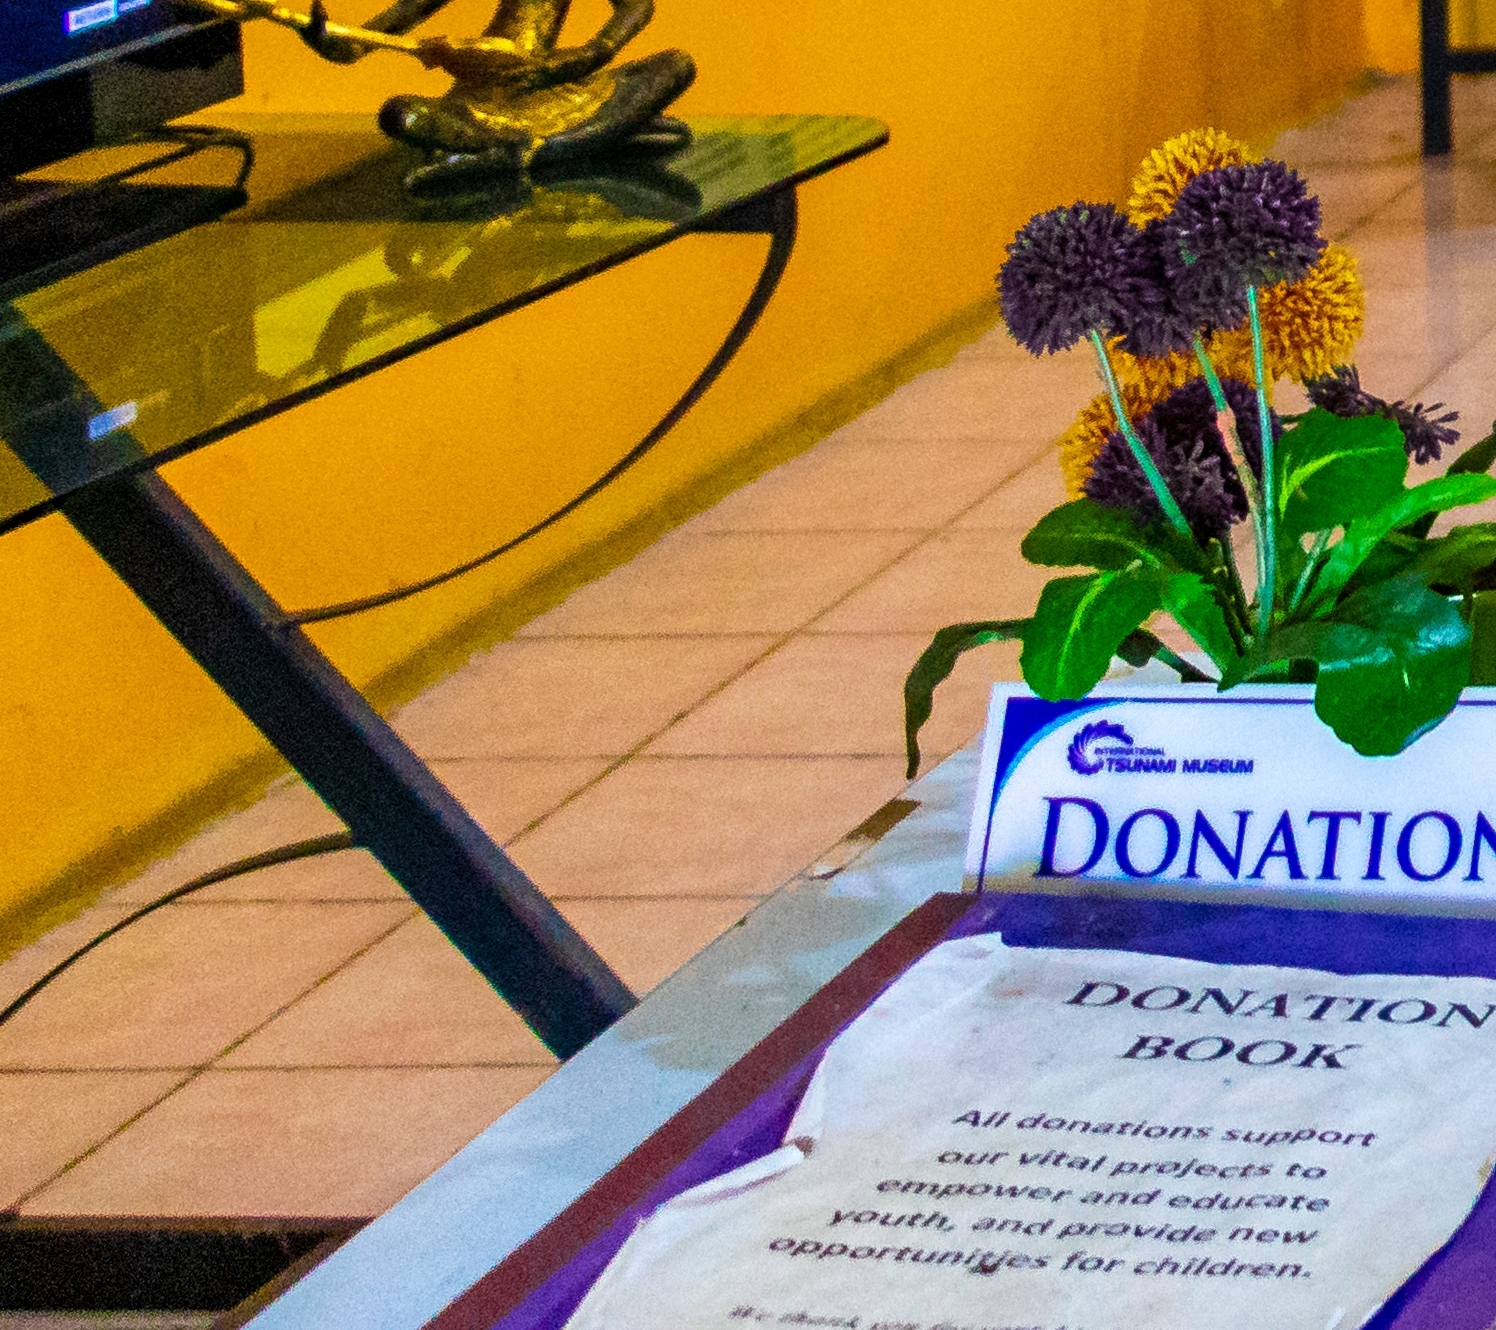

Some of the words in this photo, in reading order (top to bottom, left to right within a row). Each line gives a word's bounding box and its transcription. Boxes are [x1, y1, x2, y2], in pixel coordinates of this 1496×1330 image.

[1106, 757, 1178, 773] TSUNAMI
[1181, 758, 1254, 774] MUSEUM
[1120, 1035, 1363, 1071] BOOK
[952, 1107, 1012, 1131] All
[1022, 1112, 1213, 1141] donations
[1222, 1125, 1379, 1151] support
[936, 1146, 1012, 1169] our
[1017, 1146, 1103, 1173] vital
[1110, 1153, 1276, 1187] projects
[1284, 1160, 1329, 1182] to
[876, 1177, 1077, 1213] empower
[1081, 1187, 1159, 1213] and
[1165, 1189, 1333, 1217] educate
[827, 1207, 956, 1237] youth,
[970, 1213, 1047, 1237] and
[1055, 1217, 1221, 1248] provide
[1229, 1224, 1321, 1247] new
[766, 1232, 1052, 1278] opportunities
[1062, 1251, 1128, 1277] for
[1132, 1255, 1315, 1284] children.
